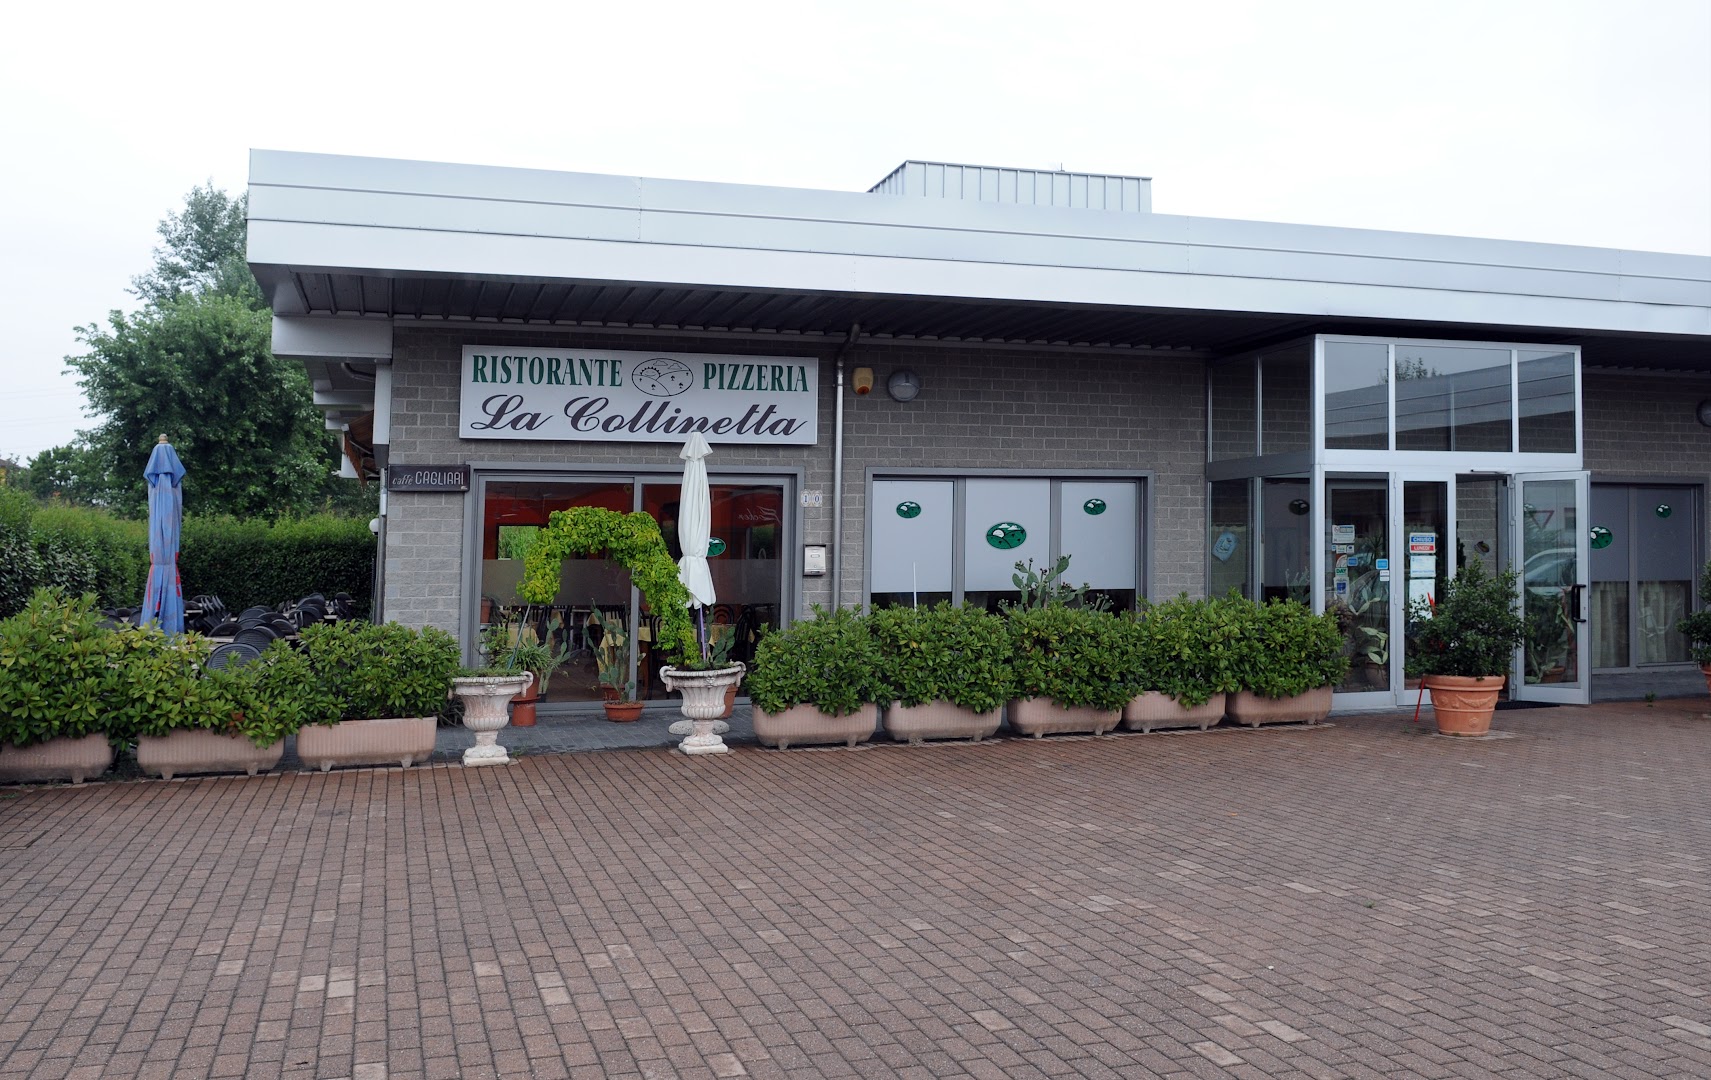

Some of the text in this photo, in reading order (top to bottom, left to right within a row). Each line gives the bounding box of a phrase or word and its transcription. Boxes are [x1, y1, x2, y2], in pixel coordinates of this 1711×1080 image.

[472, 354, 809, 392] RISTORANTE PIZZERIA
[470, 394, 808, 436] La Collinetta
[415, 471, 464, 485] CAGLIARI
